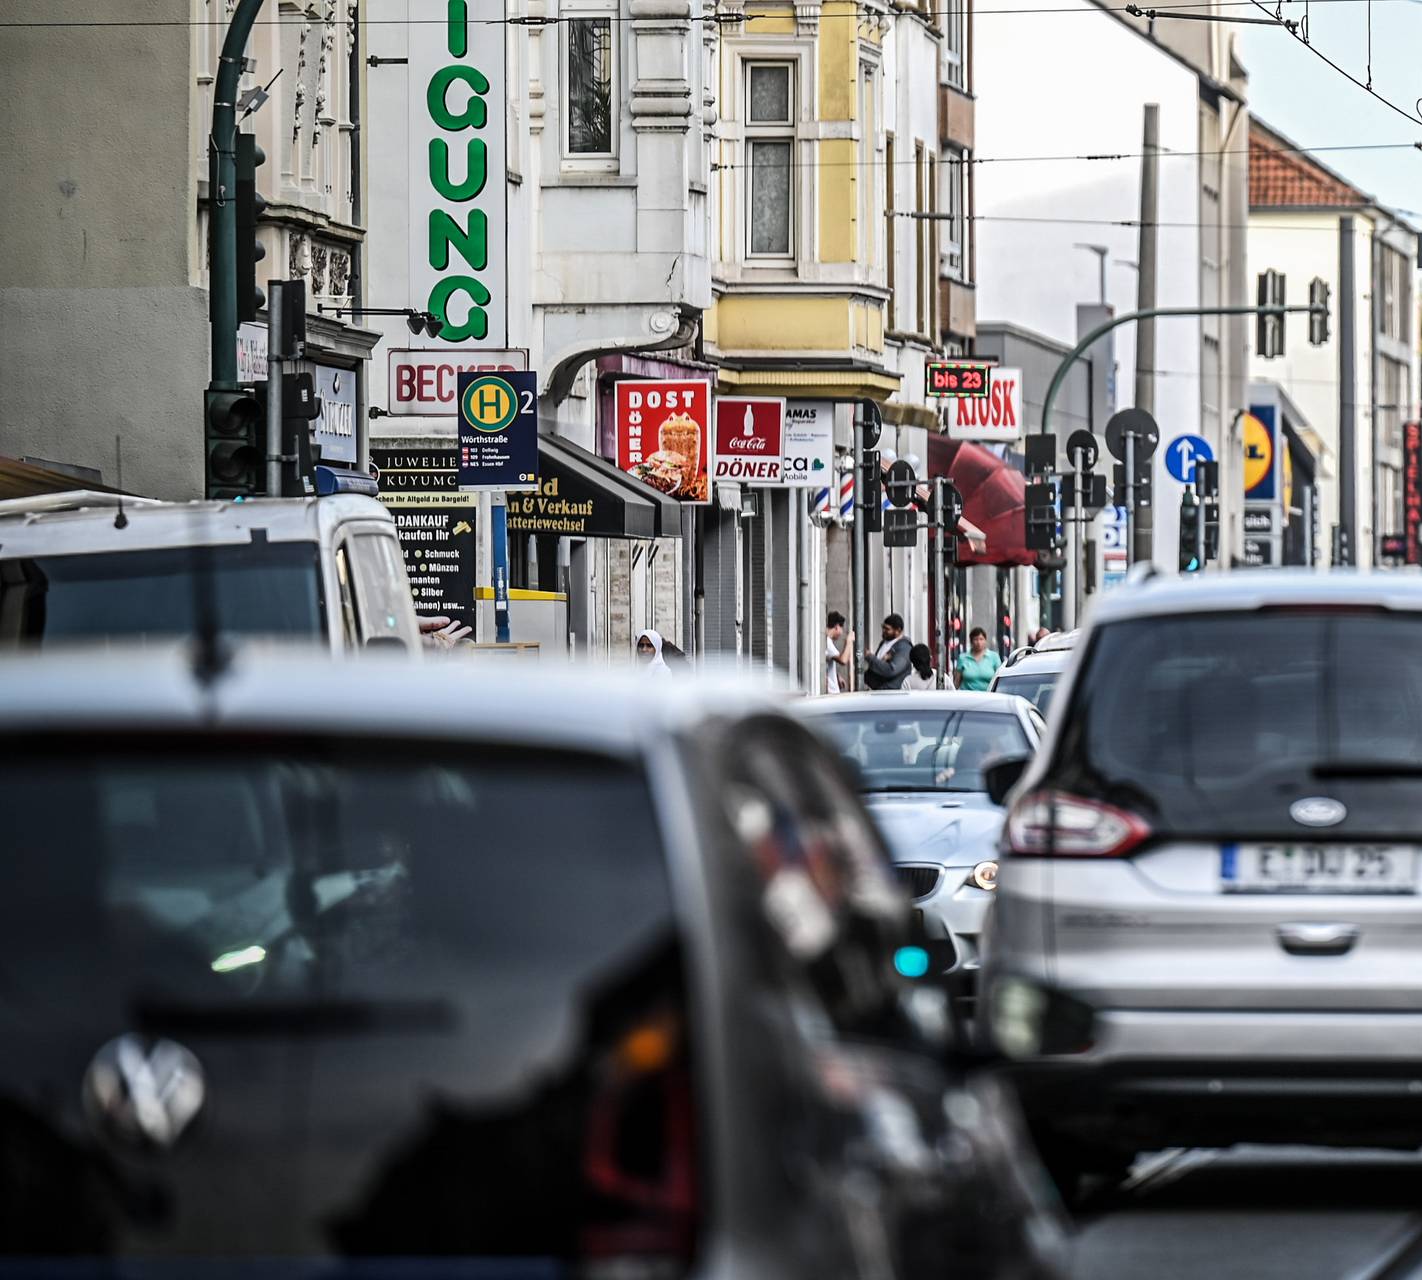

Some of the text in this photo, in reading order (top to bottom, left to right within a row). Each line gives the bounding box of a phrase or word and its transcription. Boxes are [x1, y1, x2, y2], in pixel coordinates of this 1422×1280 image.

[427, 0, 491, 342] IGUNG
[396, 364, 517, 402] BEC
[934, 371, 982, 389] bis 23
[479, 389, 534, 419] H 2
[629, 391, 694, 409] DOST
[957, 380, 1016, 427] KIOSK
[461, 435, 509, 444] Wörthstraße
[629, 411, 642, 463] DÖNER
[716, 458, 780, 478] DÖNER
[407, 495, 430, 503] Altgeld
[442, 495, 469, 503] Bargeld!
[523, 498, 534, 514] &
[537, 498, 593, 515] Verkauf
[399, 529, 449, 540] kaufen Ihr
[425, 549, 460, 558] Schmuck
[429, 563, 459, 572] Münzen
[421, 587, 444, 597] Silber
[442, 602, 465, 610] usw...
